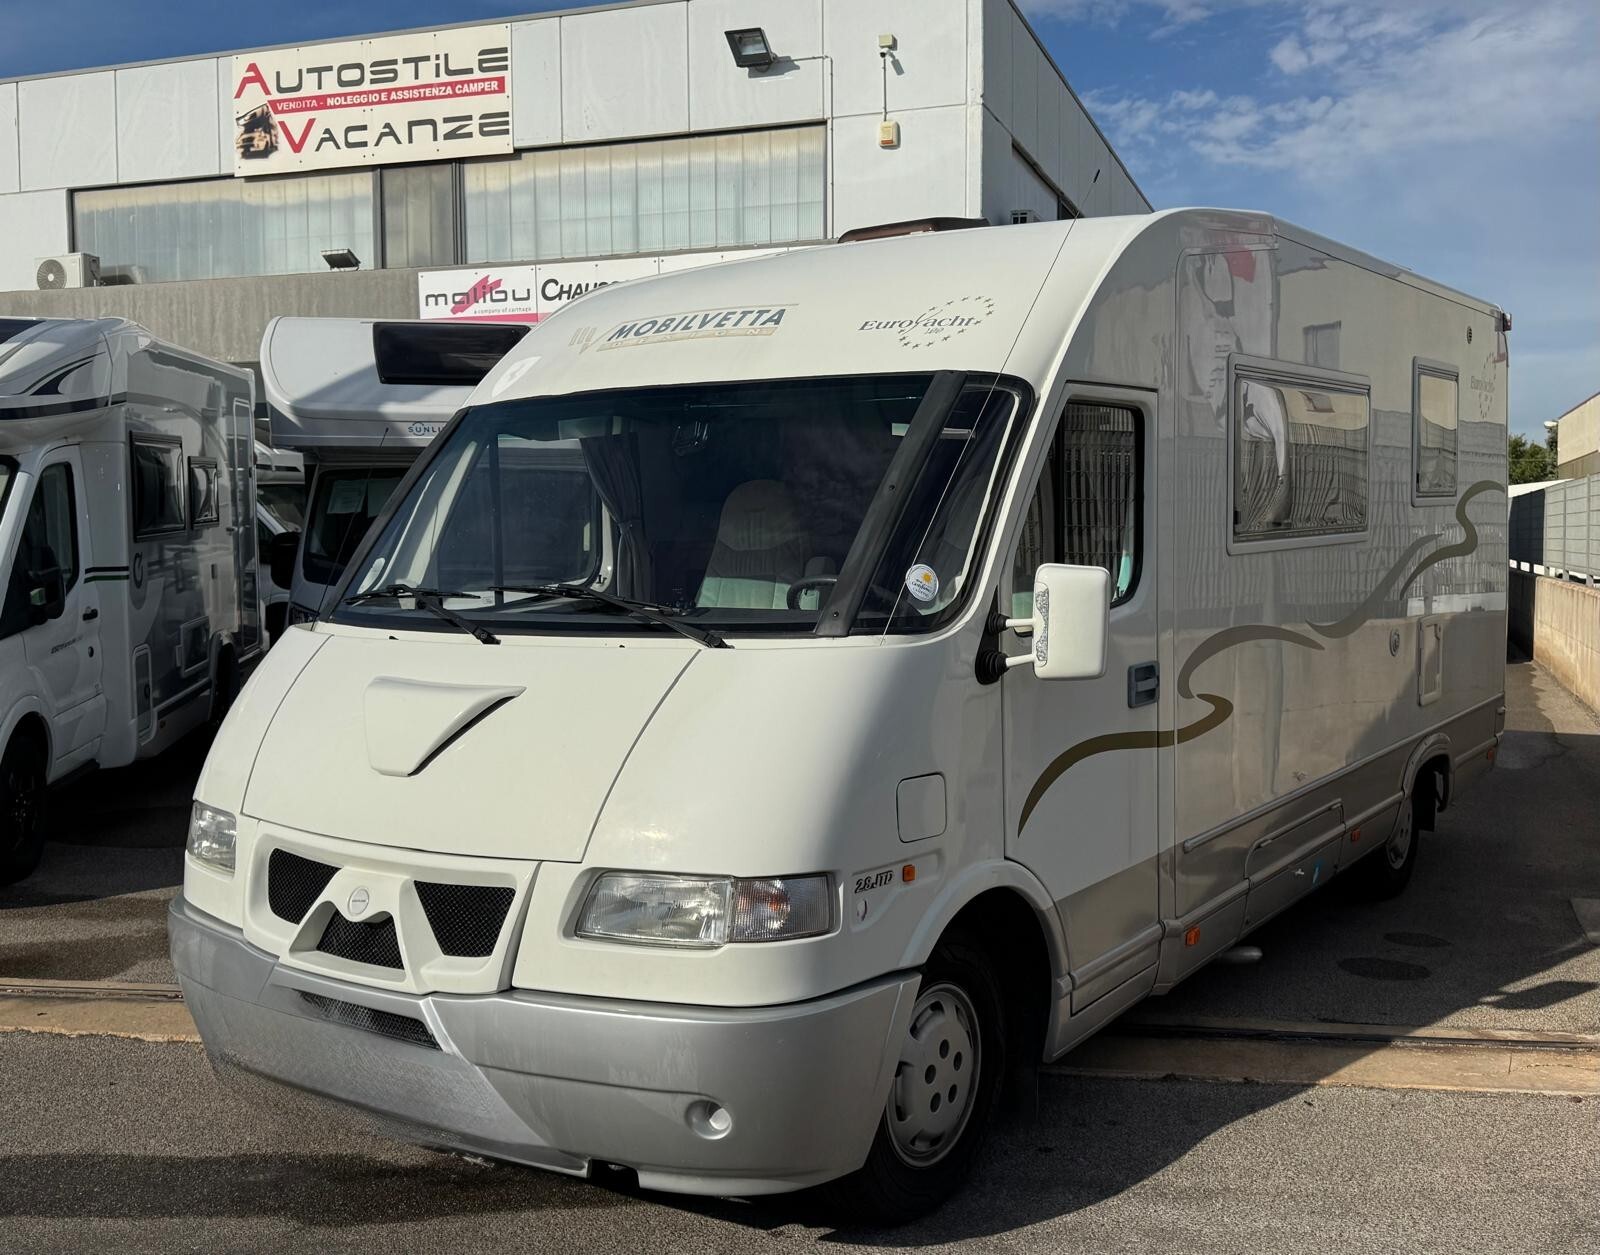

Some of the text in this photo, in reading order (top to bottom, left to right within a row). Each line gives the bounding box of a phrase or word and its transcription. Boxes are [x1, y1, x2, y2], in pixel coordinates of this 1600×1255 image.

[276, 98, 318, 111] VENDITA
[326, 93, 379, 106] NOLEGGIO
[381, 91, 388, 101] E
[390, 86, 453, 100] ASSISTENZA
[455, 81, 499, 94] CAMPER
[278, 111, 510, 154] VACANZE
[425, 285, 531, 307] malibu
[607, 308, 786, 342] MOBILVETTA
